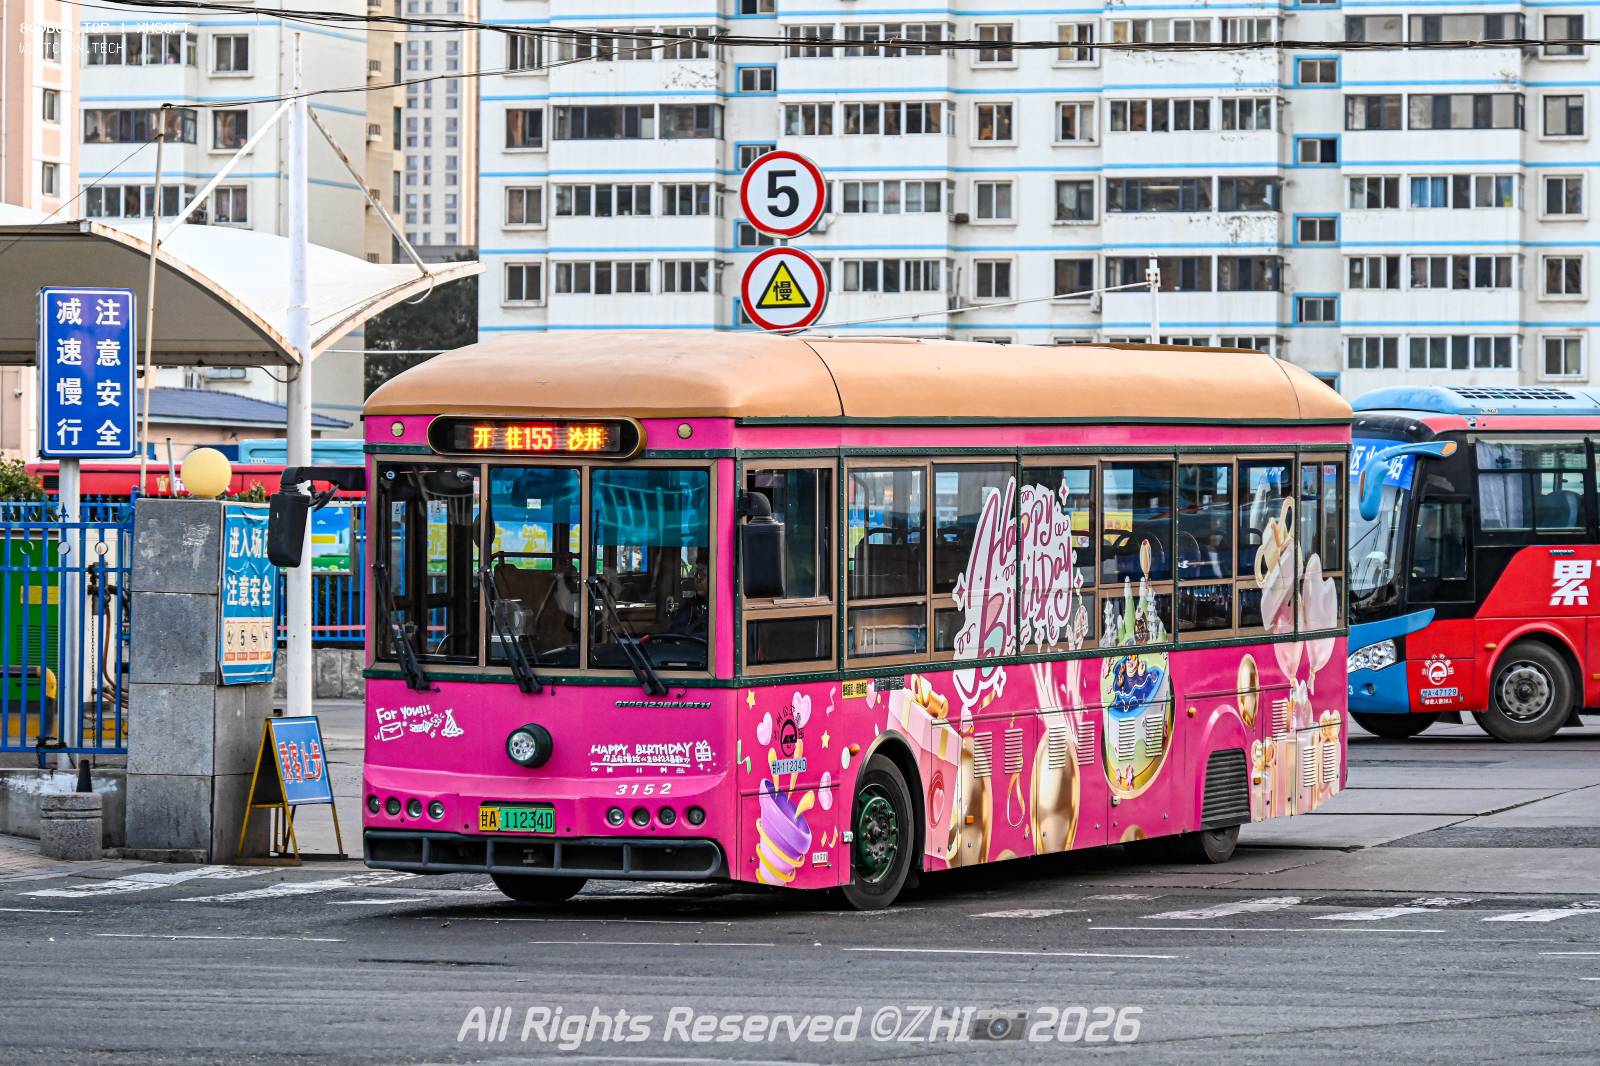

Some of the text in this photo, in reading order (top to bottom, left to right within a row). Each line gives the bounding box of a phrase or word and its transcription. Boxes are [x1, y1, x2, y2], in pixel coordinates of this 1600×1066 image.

[767, 170, 800, 217] 5
[773, 281, 793, 301] 慢
[56, 298, 83, 446] 减速慢行
[95, 298, 122, 446] 注意安全
[967, 480, 1055, 610] Happy
[226, 575, 272, 607] 注意安全
[1550, 560, 1600, 606] 累
[376, 707, 398, 724] For
[591, 742, 693, 758] HAPPY BIRTHDAY
[615, 783, 672, 795] 3152
